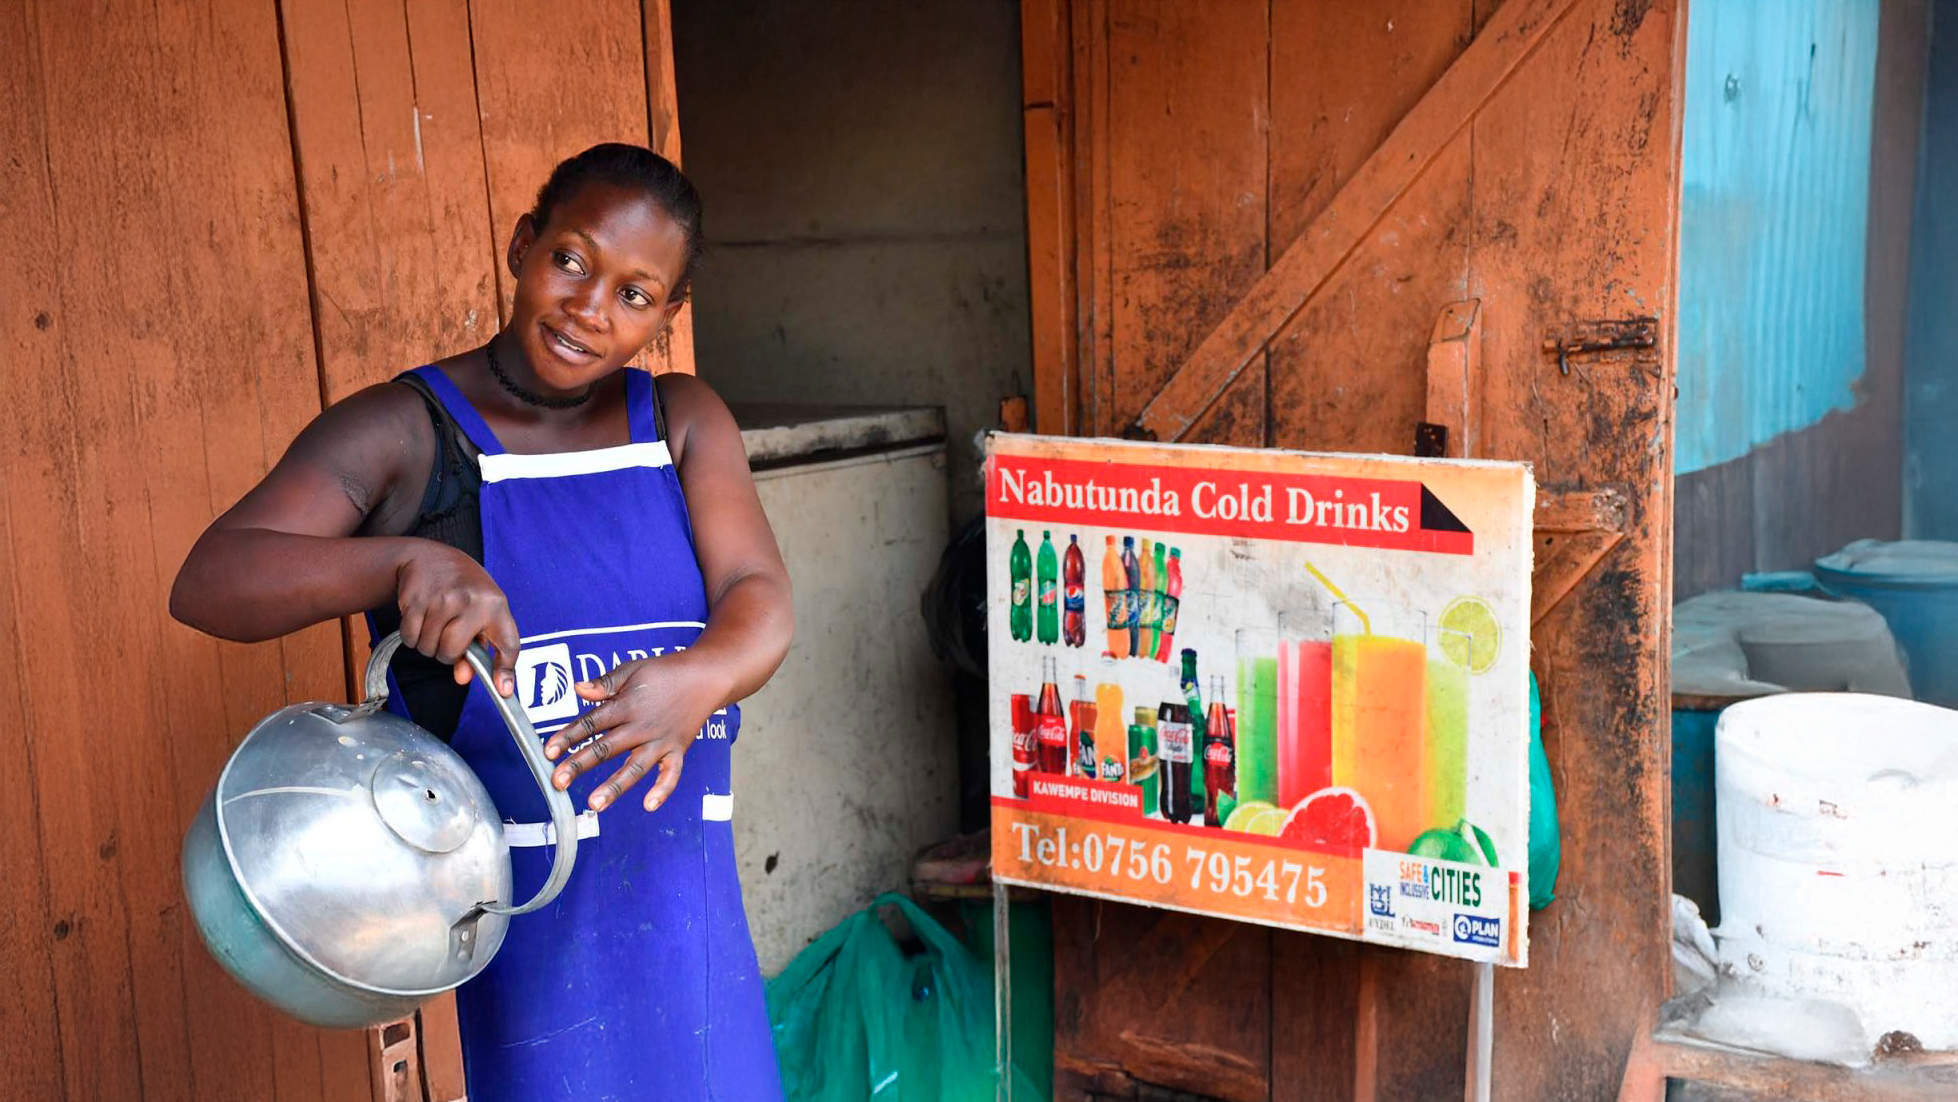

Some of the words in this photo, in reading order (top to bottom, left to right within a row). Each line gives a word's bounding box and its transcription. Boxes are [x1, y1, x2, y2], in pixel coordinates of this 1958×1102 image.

[999, 468, 1181, 517] Nabutunda
[1191, 481, 1274, 524] Cold
[1286, 488, 1410, 534] Drinks
[706, 719, 727, 740] look
[1033, 780, 1089, 801] KAWEMPE
[1090, 787, 1139, 808] DIVISION
[1011, 822, 1173, 885] Tel:0756
[1185, 846, 1328, 908] 795475
[1431, 866, 1482, 907] CITIES
[1472, 920, 1499, 938] PLAN
